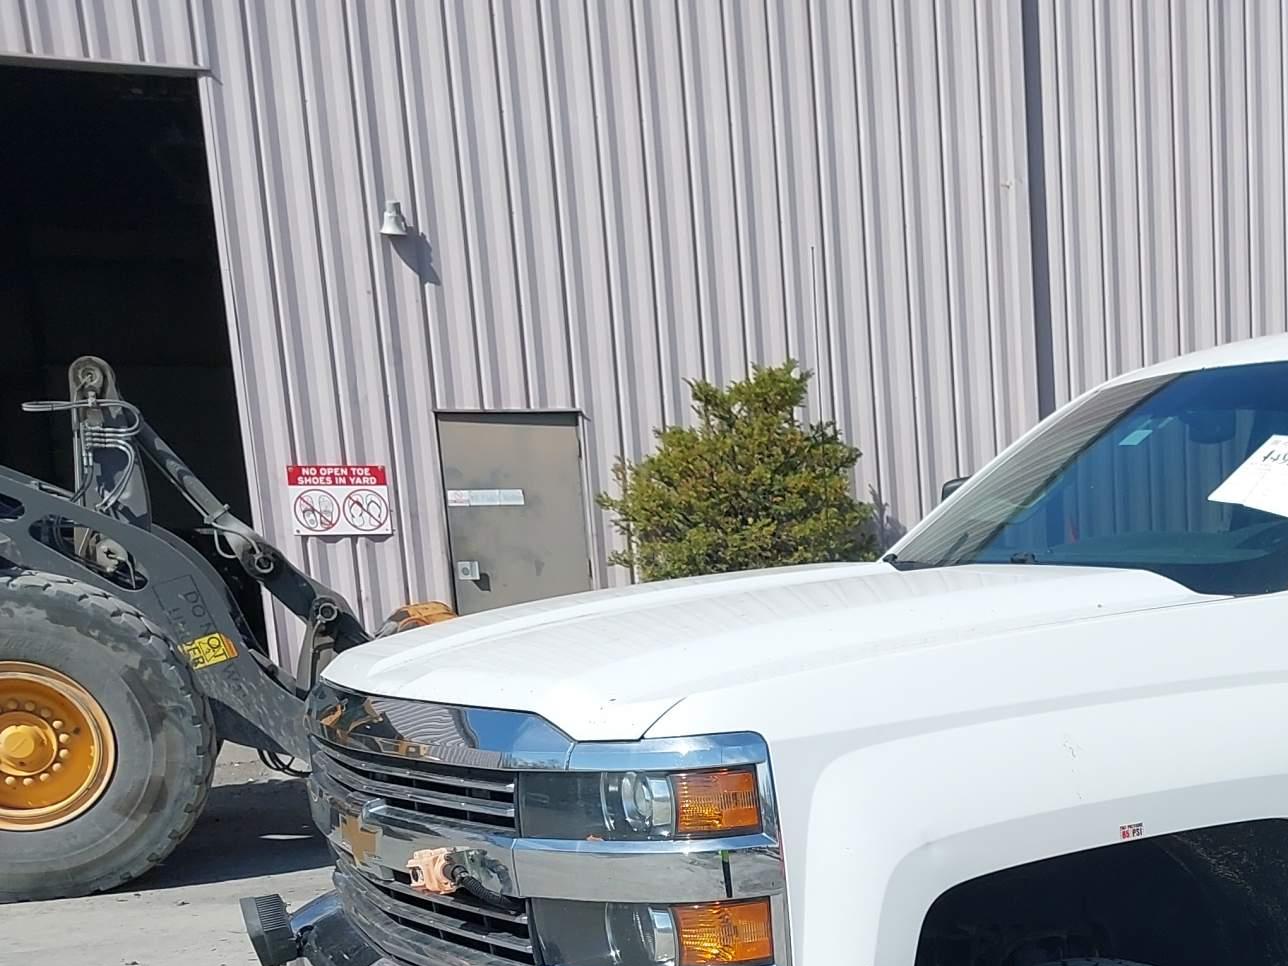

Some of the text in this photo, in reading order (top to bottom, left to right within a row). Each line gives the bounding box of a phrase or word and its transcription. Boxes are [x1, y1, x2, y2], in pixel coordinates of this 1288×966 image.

[301, 467, 371, 476] NO OPEN TOE
[297, 476, 377, 485] SHOES IN YARD
[183, 591, 228, 660] DO NOT
